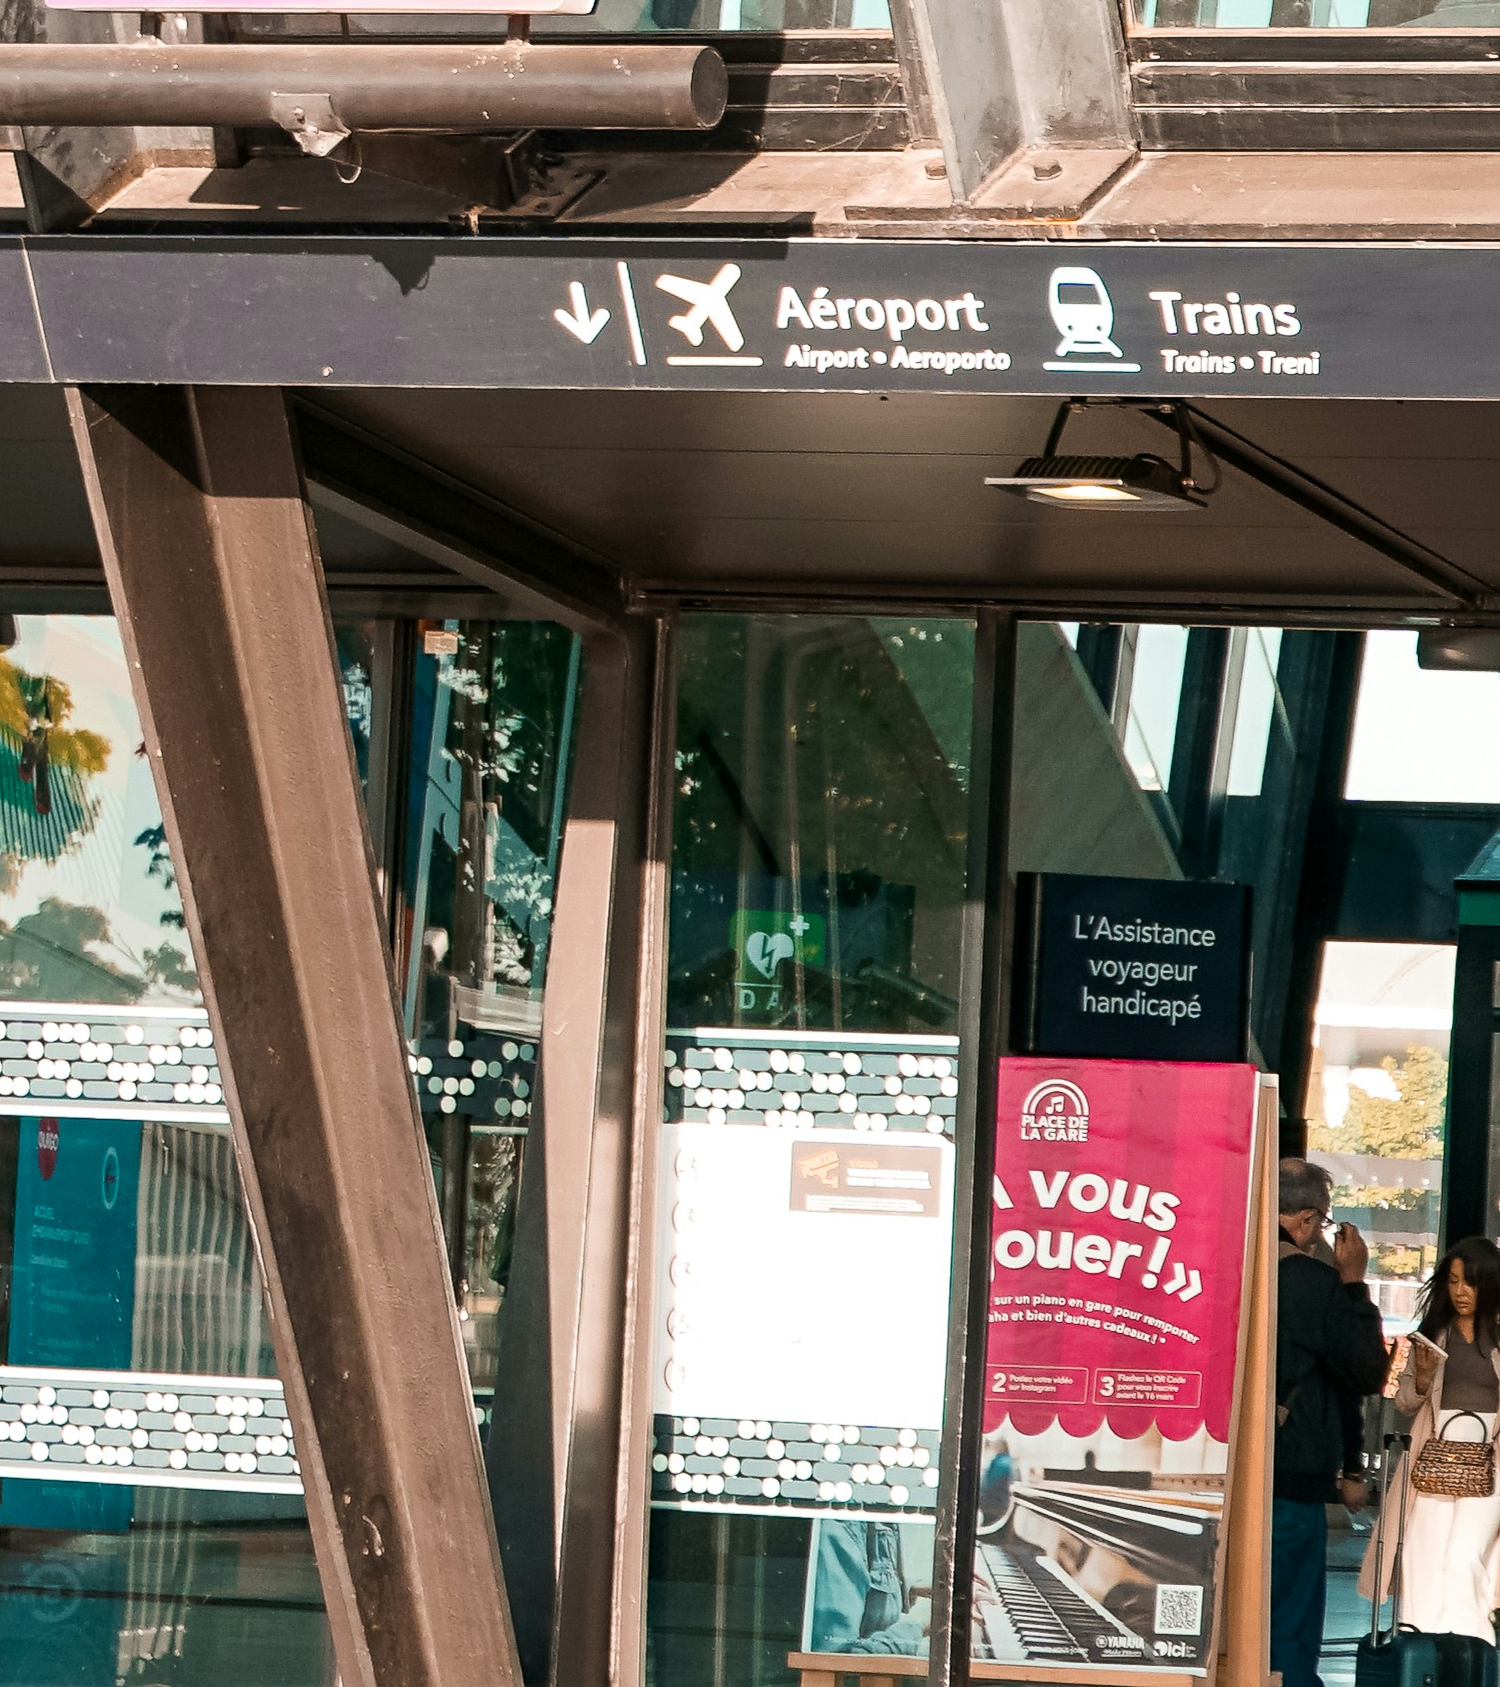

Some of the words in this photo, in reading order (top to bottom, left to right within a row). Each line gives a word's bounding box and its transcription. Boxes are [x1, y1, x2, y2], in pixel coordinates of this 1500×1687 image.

[776, 285, 989, 340] Aéroport
[1149, 290, 1302, 337] Trains
[784, 344, 869, 373] Airport
[891, 346, 1012, 375] Aeroporto
[1160, 348, 1236, 374] Trains
[1258, 349, 1320, 375] Treni
[1074, 914, 1216, 948] L'Assistance
[1088, 956, 1198, 987] voyageur
[1082, 987, 1202, 1026] handicapé
[1021, 1128, 1041, 1142] LA
[1043, 1129, 1089, 1143] GARE
[1022, 1115, 1066, 1130] PLACE
[1068, 1116, 1089, 1130] DE
[1028, 1170, 1182, 1232] vous
[994, 1296, 1013, 1305] sur
[1015, 1296, 1030, 1305] un
[1032, 1293, 1066, 1310] piano
[1068, 1298, 1083, 1308] en
[1085, 1300, 1112, 1313] gare
[1113, 1306, 1143, 1321] pour
[1143, 1315, 1200, 1344] remporter
[1011, 1311, 1024, 1322] et
[1026, 1310, 1052, 1322] bien
[1054, 1311, 1101, 1329] d'autres
[992, 1372, 1006, 1393] 2
[1100, 1376, 1115, 1397] 3
[1153, 1375, 1166, 1384] QR
[1166, 1375, 1186, 1384] Code
[1107, 1635, 1145, 1649] YAMAHA
